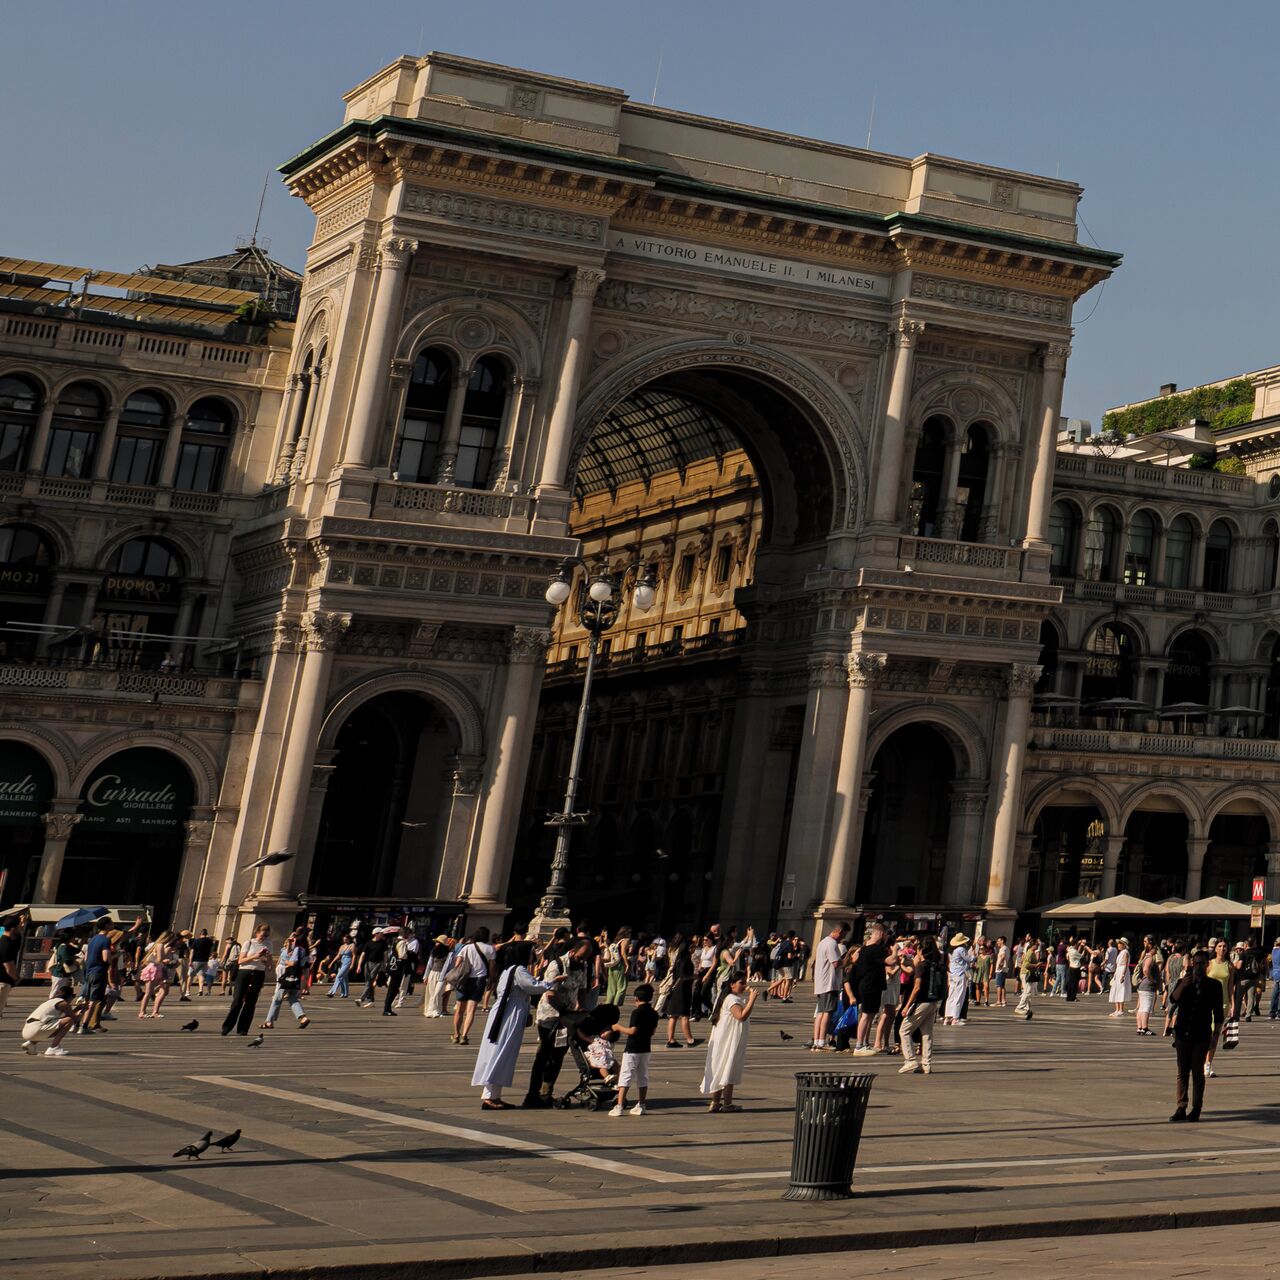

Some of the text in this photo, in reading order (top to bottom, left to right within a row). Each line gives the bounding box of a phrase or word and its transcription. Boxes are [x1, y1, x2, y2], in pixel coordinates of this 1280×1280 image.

[615, 238, 625, 247] A
[634, 240, 697, 259] VITTORIO
[704, 252, 777, 273] EMANUELE
[805, 270, 810, 278] I
[817, 271, 875, 289] MILANESI
[25, 572, 40, 585] 21
[107, 578, 171, 593] DUOMO 21
[87, 774, 177, 807] Currado
[123, 801, 174, 810] GIOIELLERIE
[141, 818, 178, 826] SANREMO
[1253, 883, 1264, 897] M
